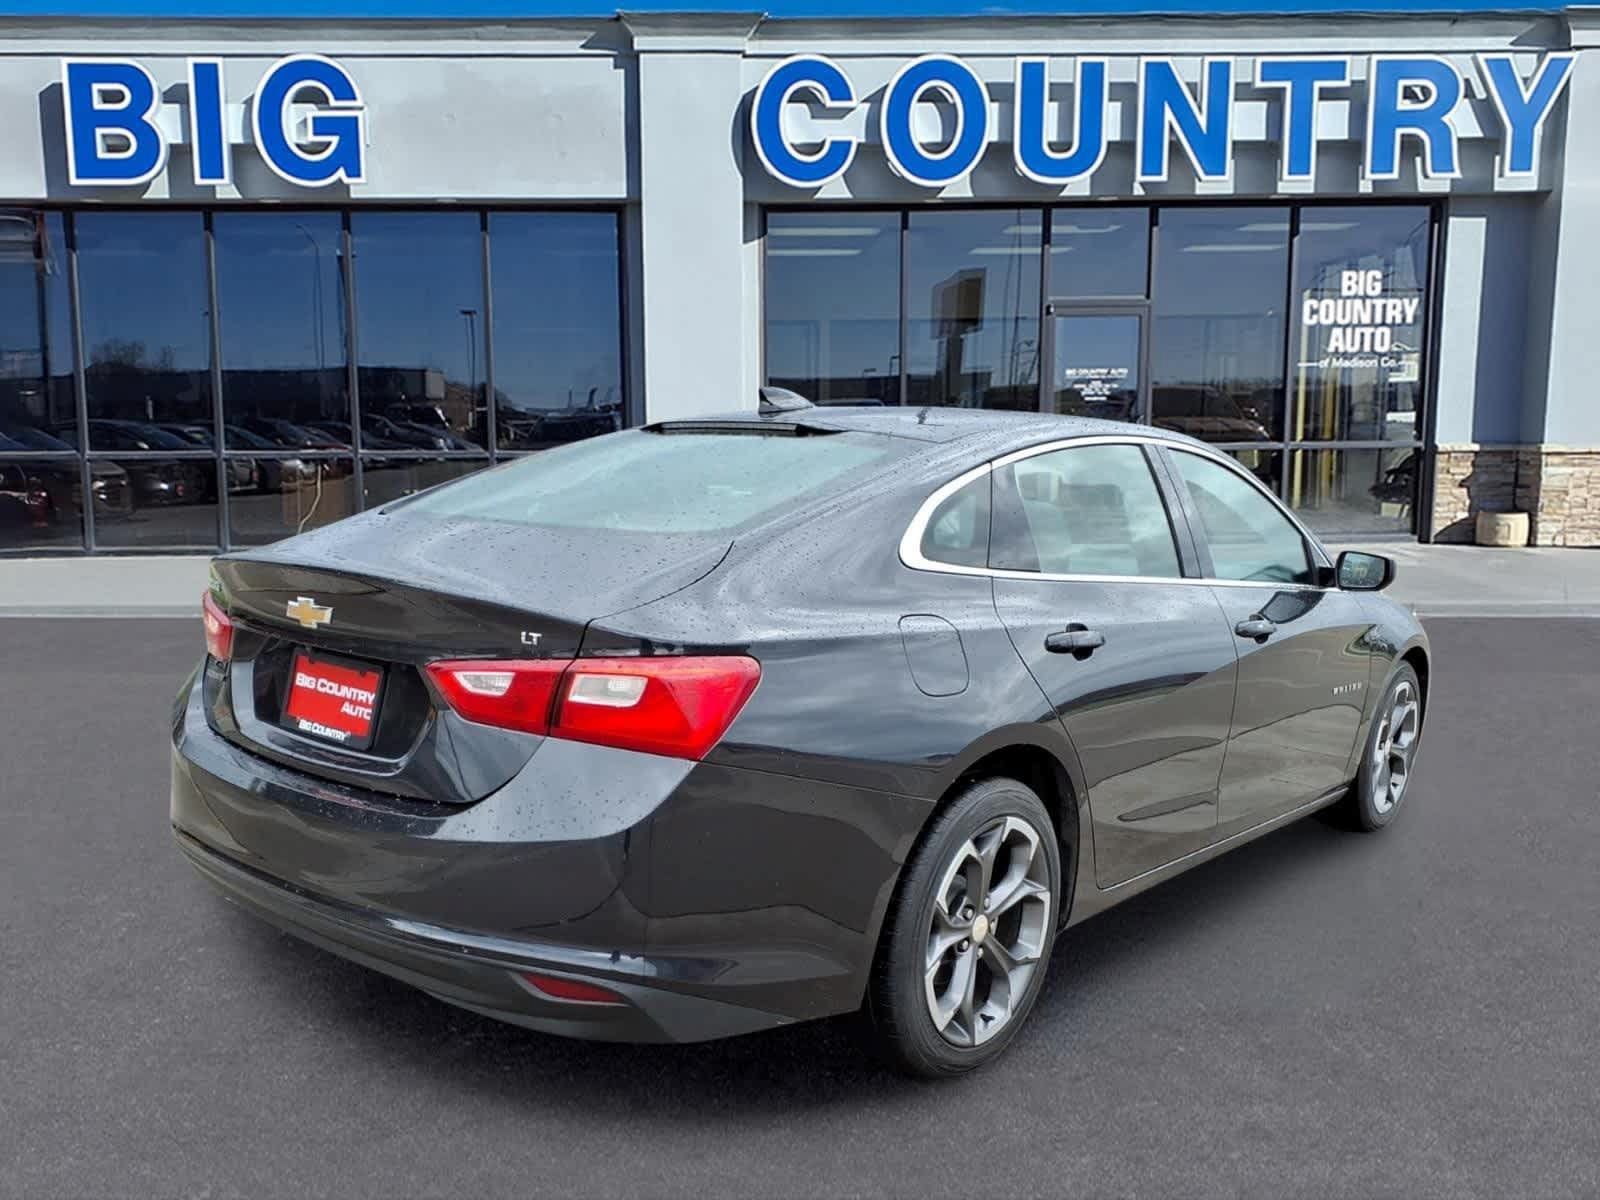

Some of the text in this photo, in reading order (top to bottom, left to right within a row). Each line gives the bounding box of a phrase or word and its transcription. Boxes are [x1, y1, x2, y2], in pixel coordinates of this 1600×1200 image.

[61, 53, 1575, 188] BIG COUNTRY
[1341, 269, 1382, 297] BIG
[1302, 297, 1419, 326] COUNTRY
[1327, 326, 1391, 353] AUTO
[1319, 357, 1330, 369] of
[1330, 356, 1378, 368] Madison
[521, 631, 542, 645] LT
